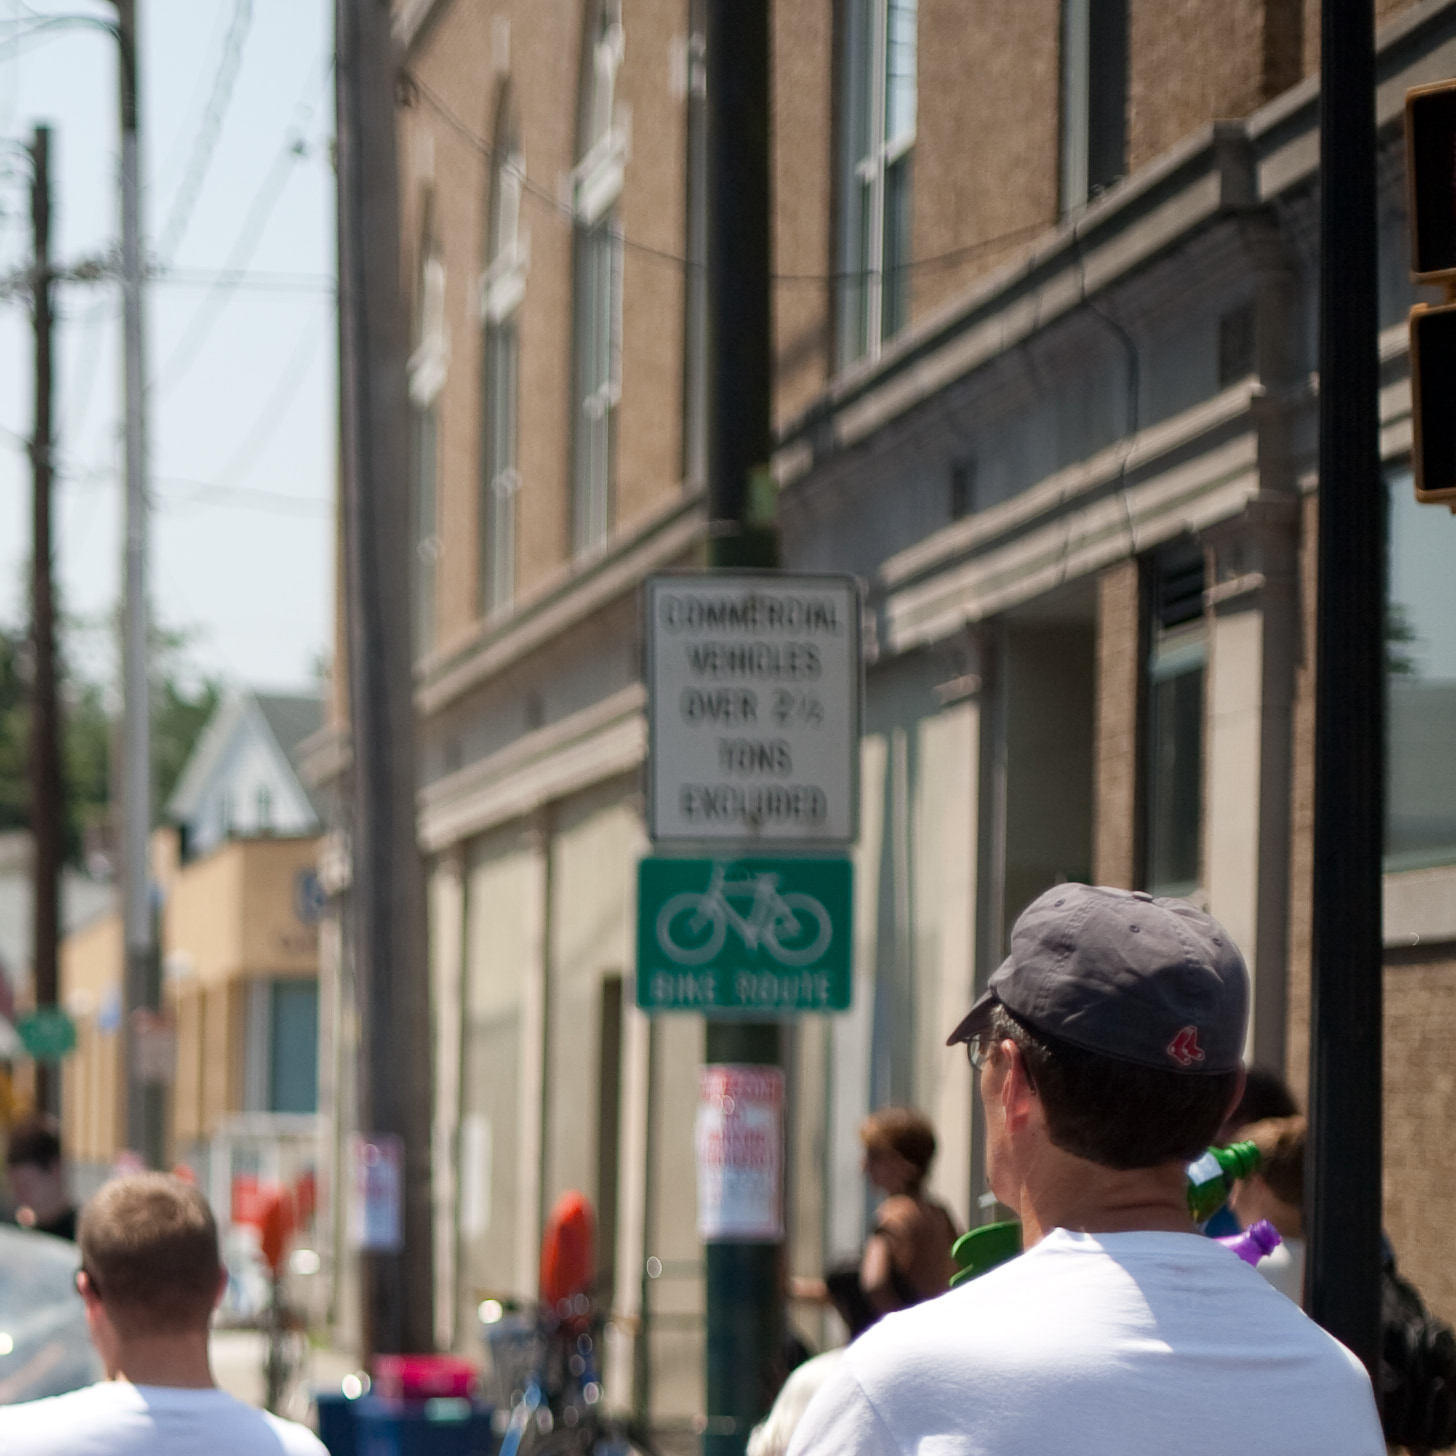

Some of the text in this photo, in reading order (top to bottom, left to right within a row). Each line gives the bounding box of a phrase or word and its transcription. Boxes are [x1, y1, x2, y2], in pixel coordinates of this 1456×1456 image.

[663, 595, 841, 634] COMMERCIAL
[687, 642, 821, 679] VEHICLES
[681, 687, 757, 725] OVER
[719, 738, 792, 777] TONS
[681, 785, 828, 823] EXCLUDED
[651, 972, 834, 1002] BIKE ROUTE
